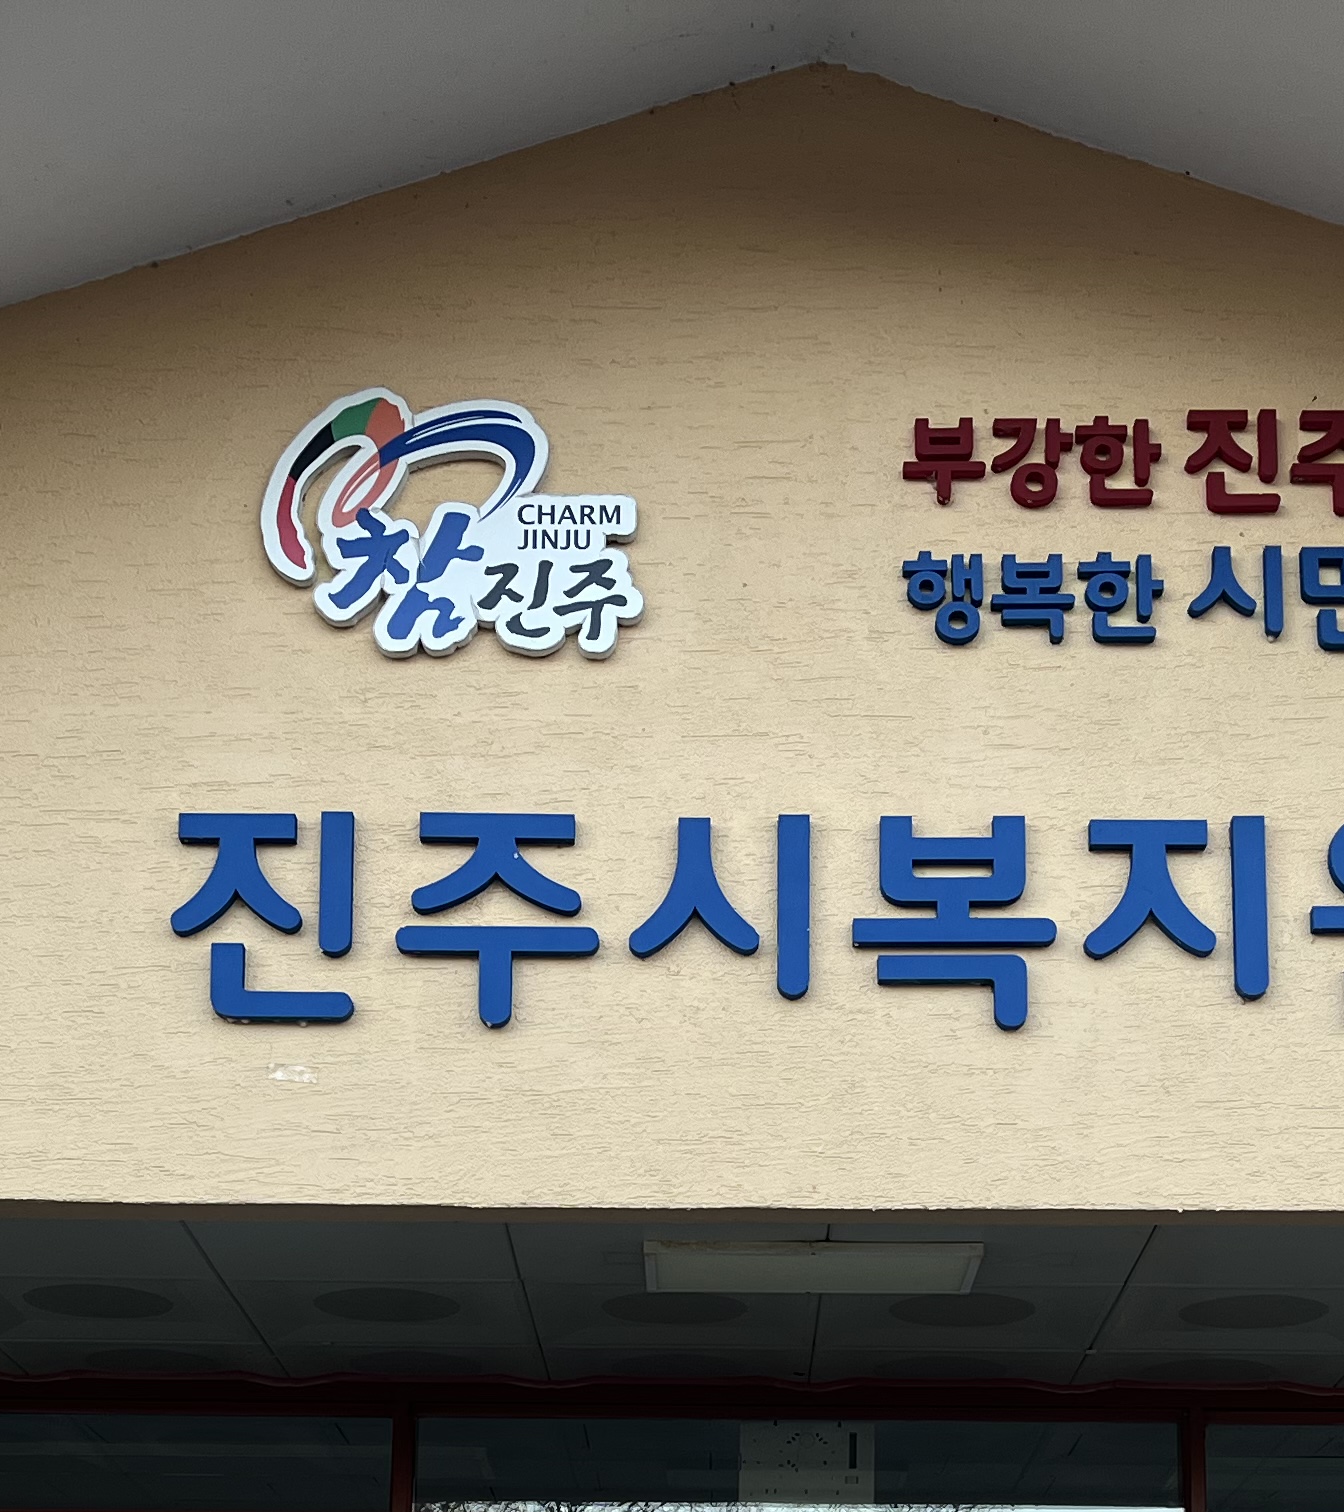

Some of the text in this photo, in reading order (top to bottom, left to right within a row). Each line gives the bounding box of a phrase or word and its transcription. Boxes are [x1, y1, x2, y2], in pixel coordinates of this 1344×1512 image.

[903, 415, 1162, 508] 부강한
[516, 505, 623, 529] CHARM
[516, 529, 592, 552] JINJU
[332, 508, 630, 643] 참 진주
[902, 549, 1164, 648] 행복한
